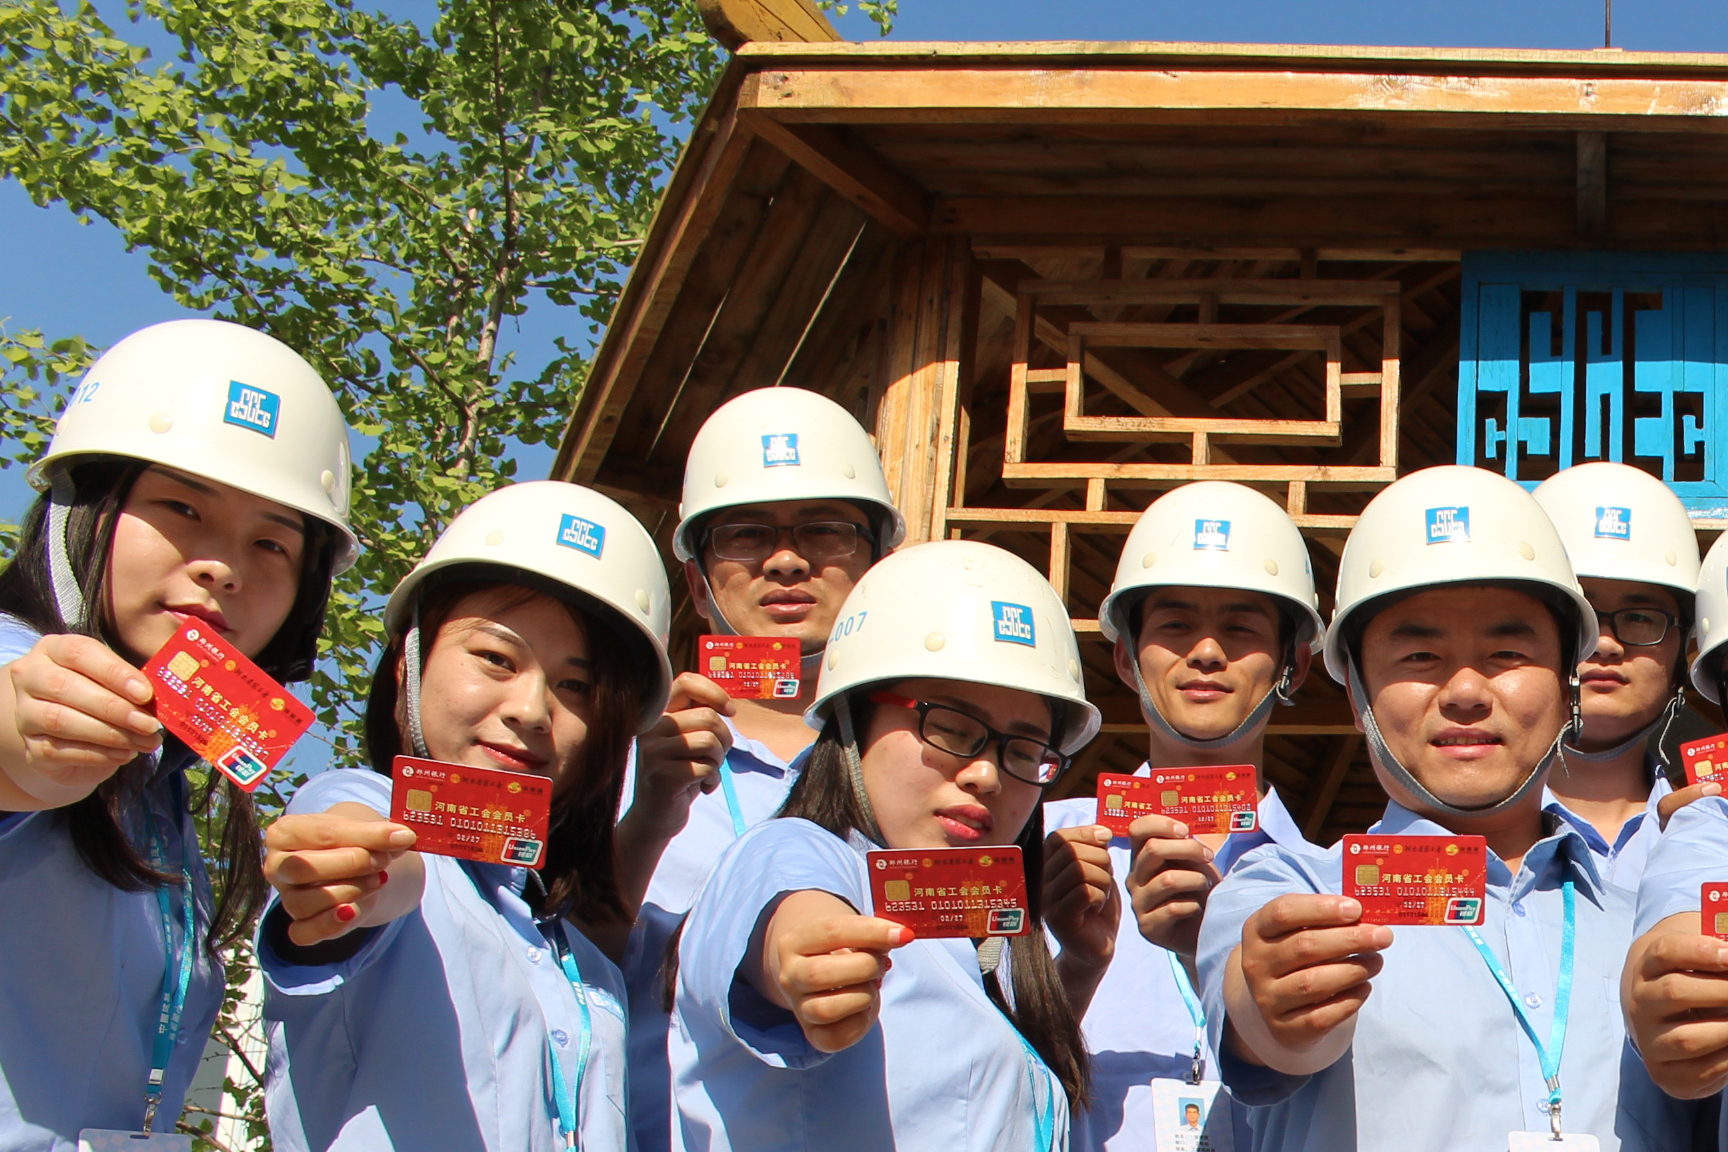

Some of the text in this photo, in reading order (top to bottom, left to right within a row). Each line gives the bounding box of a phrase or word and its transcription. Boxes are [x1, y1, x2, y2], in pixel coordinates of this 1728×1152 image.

[190, 675, 269, 742] 河南省工会会员卡
[228, 751, 257, 777] UnionPay
[1181, 794, 1241, 803] 河南省工会会员卡
[435, 801, 525, 824] 河南省工会会员卡
[402, 810, 536, 839] 623531 0101011315386
[456, 833, 479, 843] 02/27
[507, 843, 536, 855] UnionPay
[1382, 874, 1464, 883] 河南省工会会员卡
[913, 885, 1003, 897] 河南省工会会员卡
[1354, 887, 1390, 896] 623531
[884, 898, 1017, 912] 623531 0101011315345
[1450, 904, 1476, 912] UnionPay
[991, 915, 1019, 924] UnionPay
